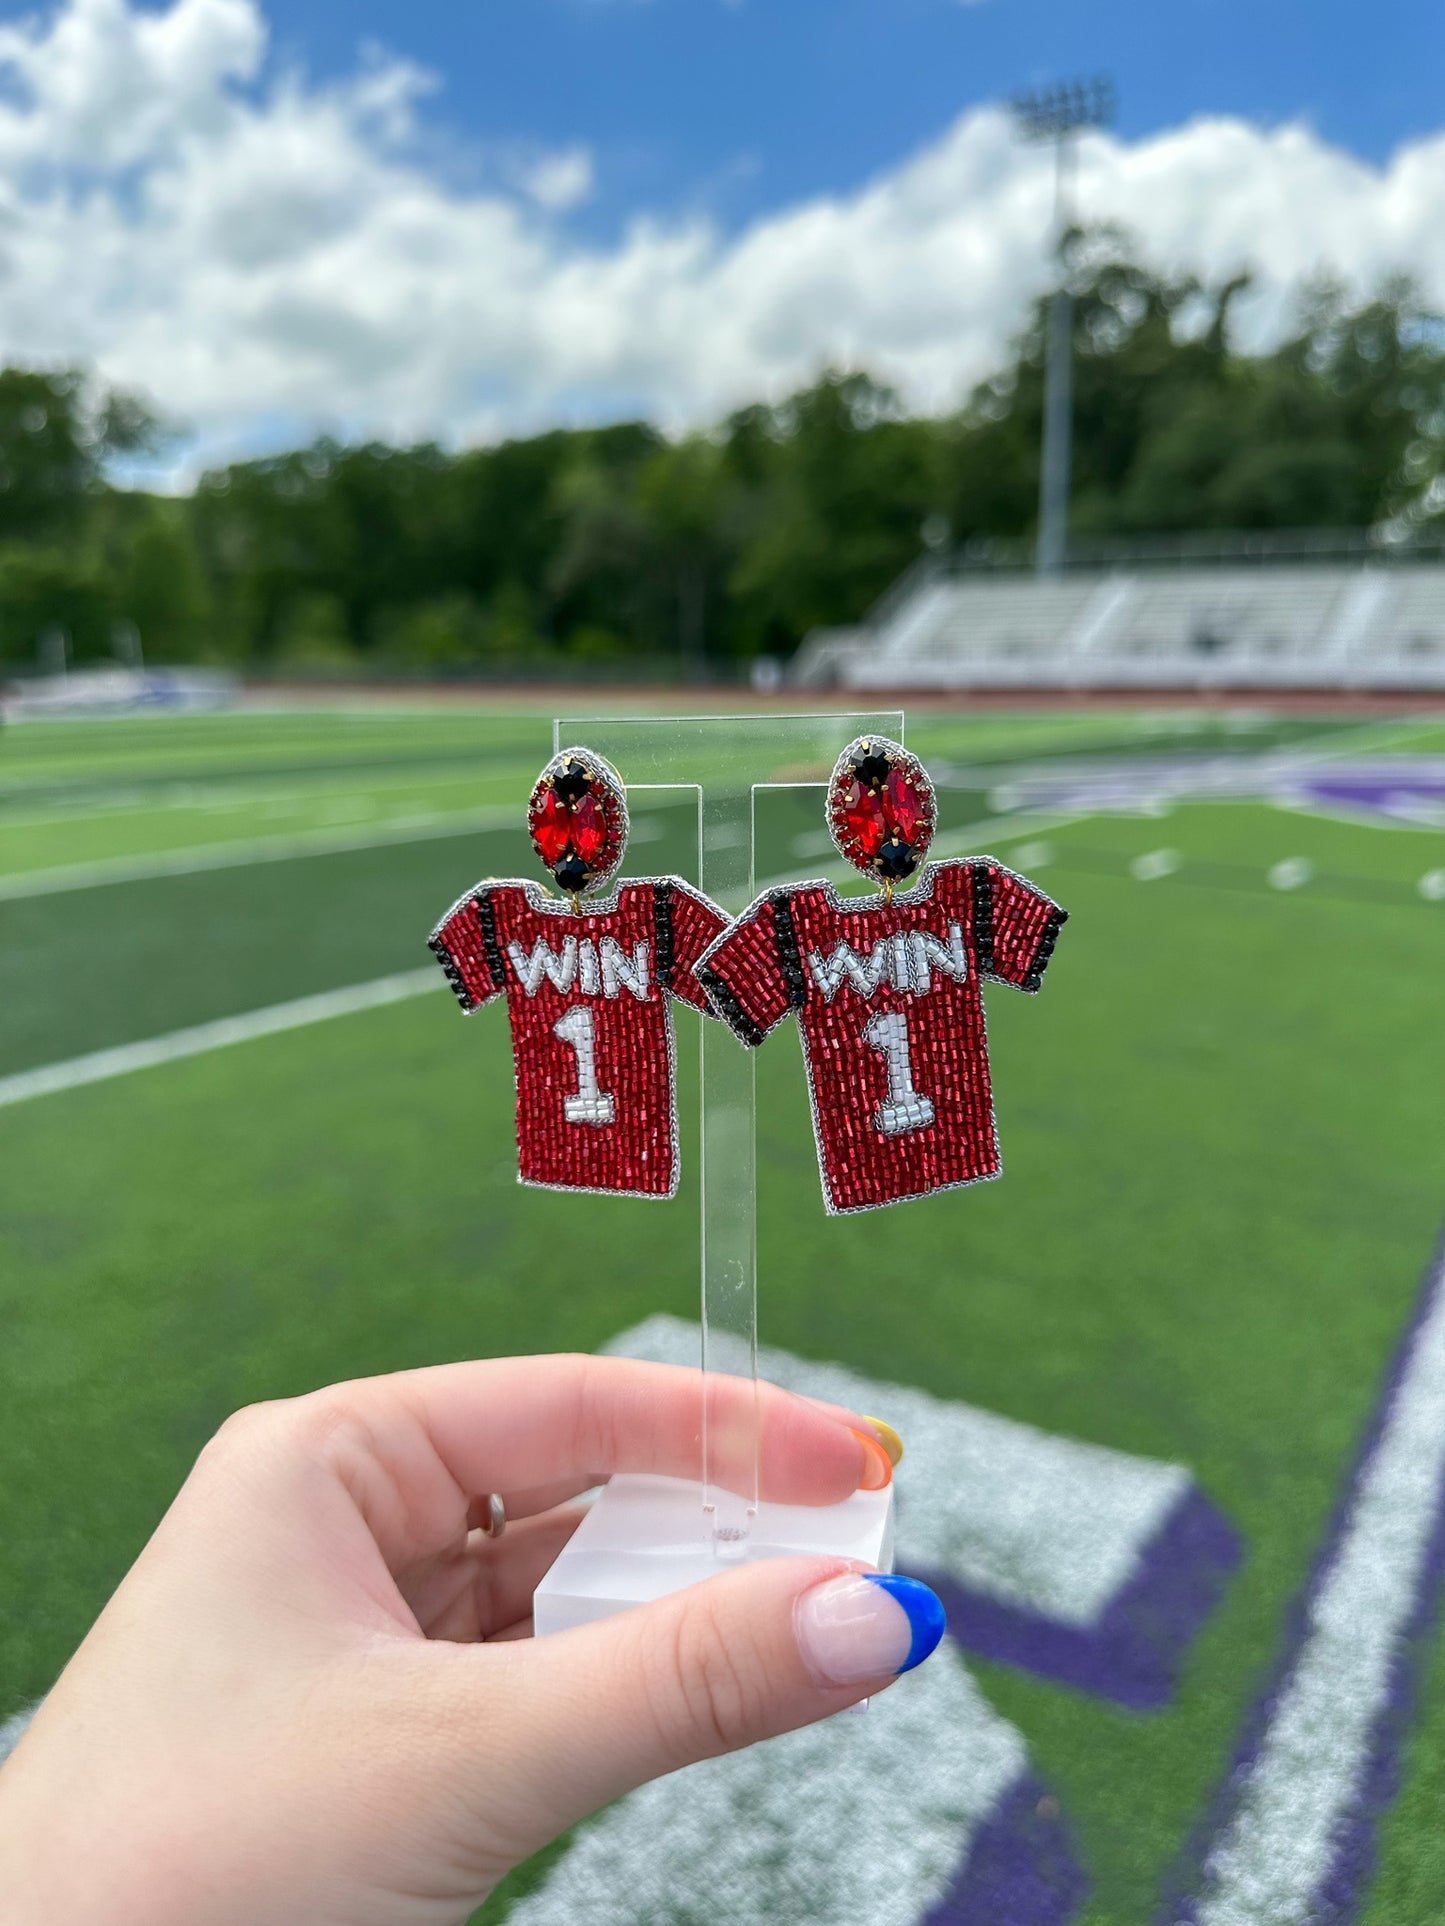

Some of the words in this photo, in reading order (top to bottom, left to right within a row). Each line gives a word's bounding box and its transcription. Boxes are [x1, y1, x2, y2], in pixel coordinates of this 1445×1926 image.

[507, 935, 650, 1001] WIN
[807, 918, 967, 1002] WIN
[553, 1005, 614, 1126] 1
[861, 1010, 935, 1135] 1
